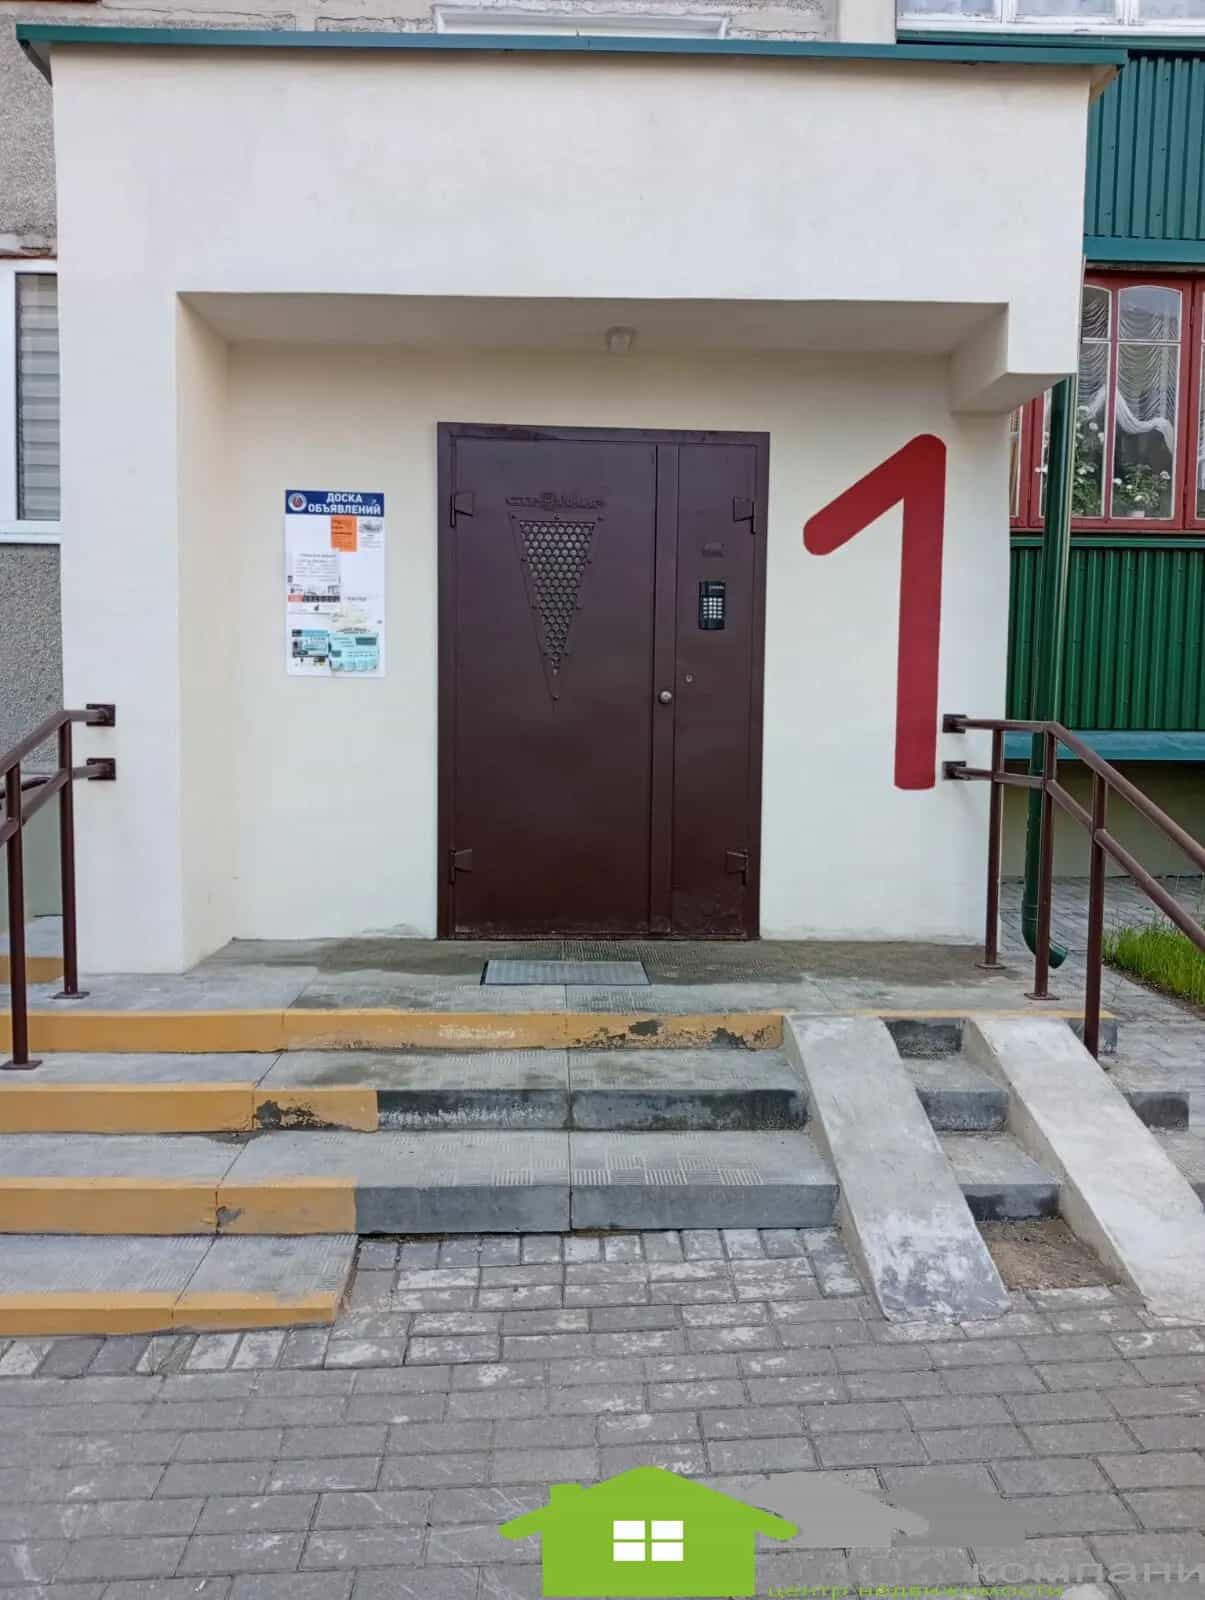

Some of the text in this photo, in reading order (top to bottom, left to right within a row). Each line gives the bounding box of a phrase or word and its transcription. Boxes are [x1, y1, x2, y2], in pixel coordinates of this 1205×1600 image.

[326, 492, 363, 504] ДОСКА
[307, 503, 381, 515] ОБЪЯВЛЕНИЙ
[803, 434, 946, 790] 1
